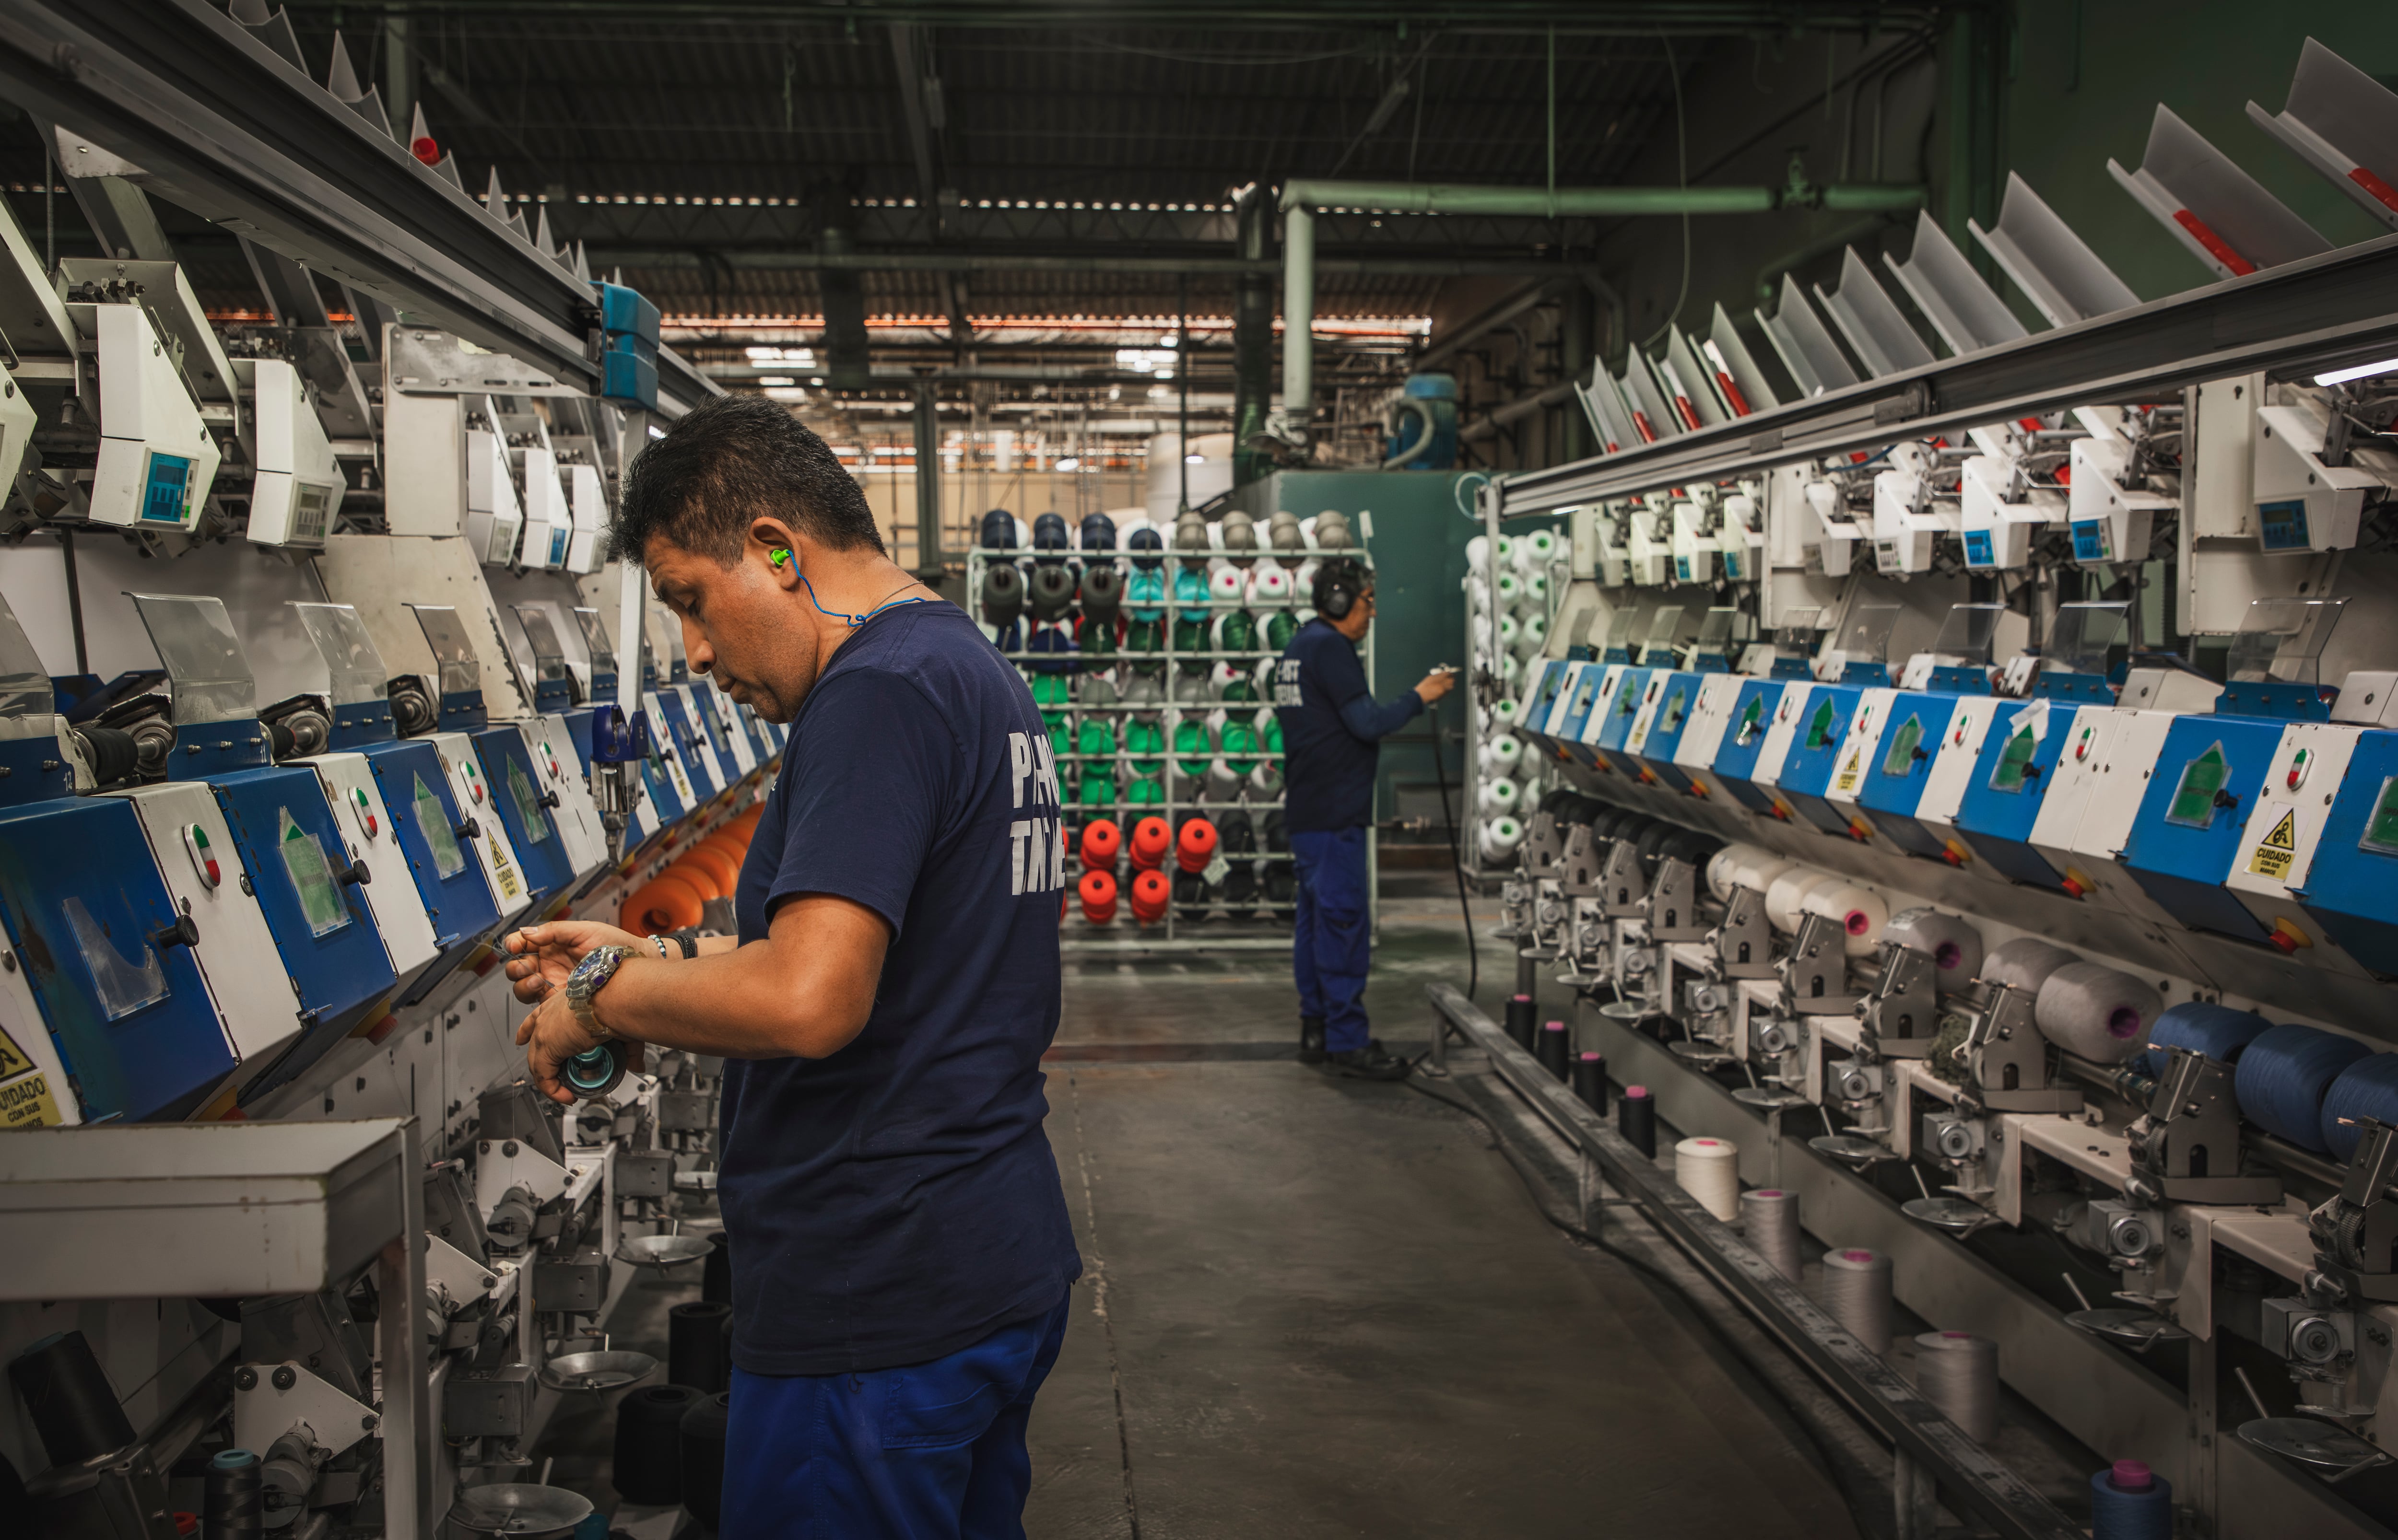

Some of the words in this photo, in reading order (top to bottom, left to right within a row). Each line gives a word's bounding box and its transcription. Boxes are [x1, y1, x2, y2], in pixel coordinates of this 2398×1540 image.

[2257, 848, 2292, 863] CUIDADO
[0, 1077, 45, 1111] UIDADO
[8, 1108, 25, 1122] CON
[24, 1101, 41, 1115] SUS
